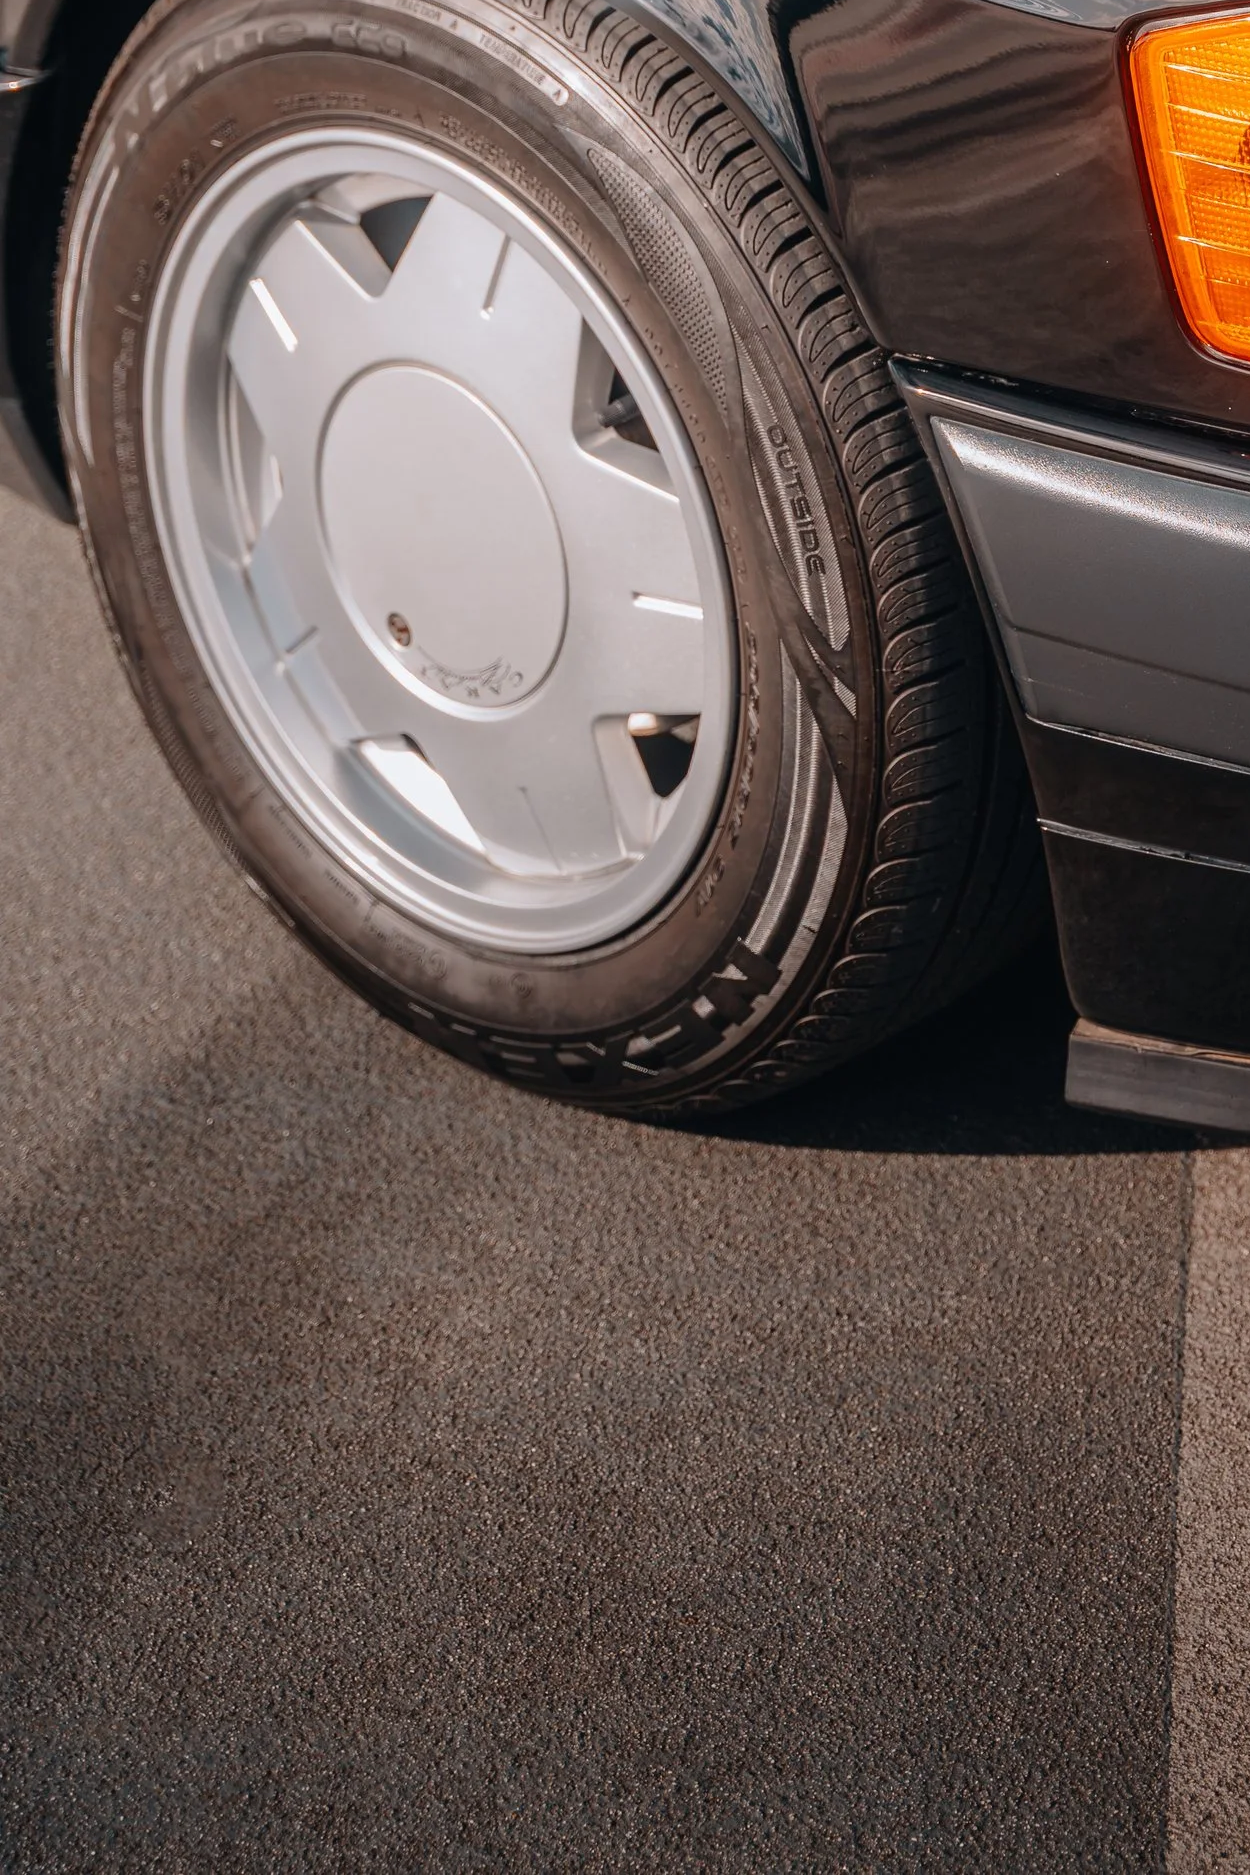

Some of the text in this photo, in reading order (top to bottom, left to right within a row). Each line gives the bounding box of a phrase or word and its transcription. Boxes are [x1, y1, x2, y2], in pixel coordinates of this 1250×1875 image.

[450, 18, 459, 30] A
[478, 33, 546, 86] TEMPERATURE
[552, 88, 563, 100] A
[766, 424, 826, 576] OUTSIDE
